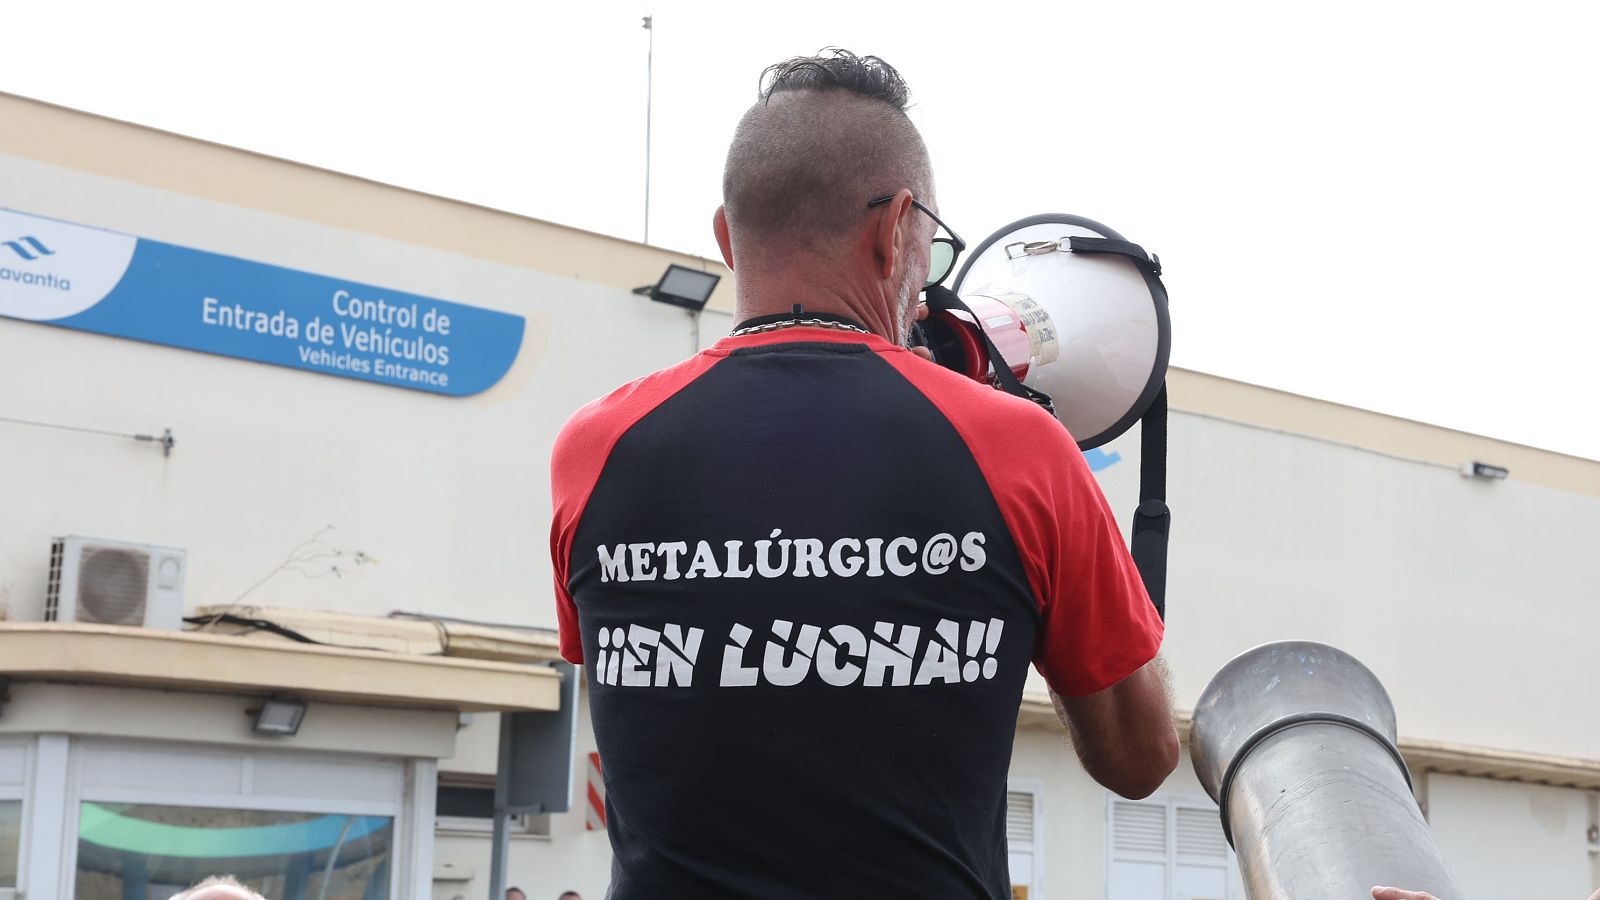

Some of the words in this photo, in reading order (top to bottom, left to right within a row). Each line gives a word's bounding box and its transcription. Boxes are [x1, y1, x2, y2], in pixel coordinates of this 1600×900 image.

[202, 297, 299, 339] Entrada
[305, 316, 335, 346] de
[340, 322, 449, 366] Vehículos
[332, 289, 417, 329] Control
[423, 307, 450, 335] de
[298, 345, 371, 374] Vehicles
[374, 358, 449, 387] Entrance
[597, 528, 987, 583] METALÚRGIC@S
[597, 622, 705, 688] ¡¡EN
[719, 617, 1005, 688] LUCHA!!
